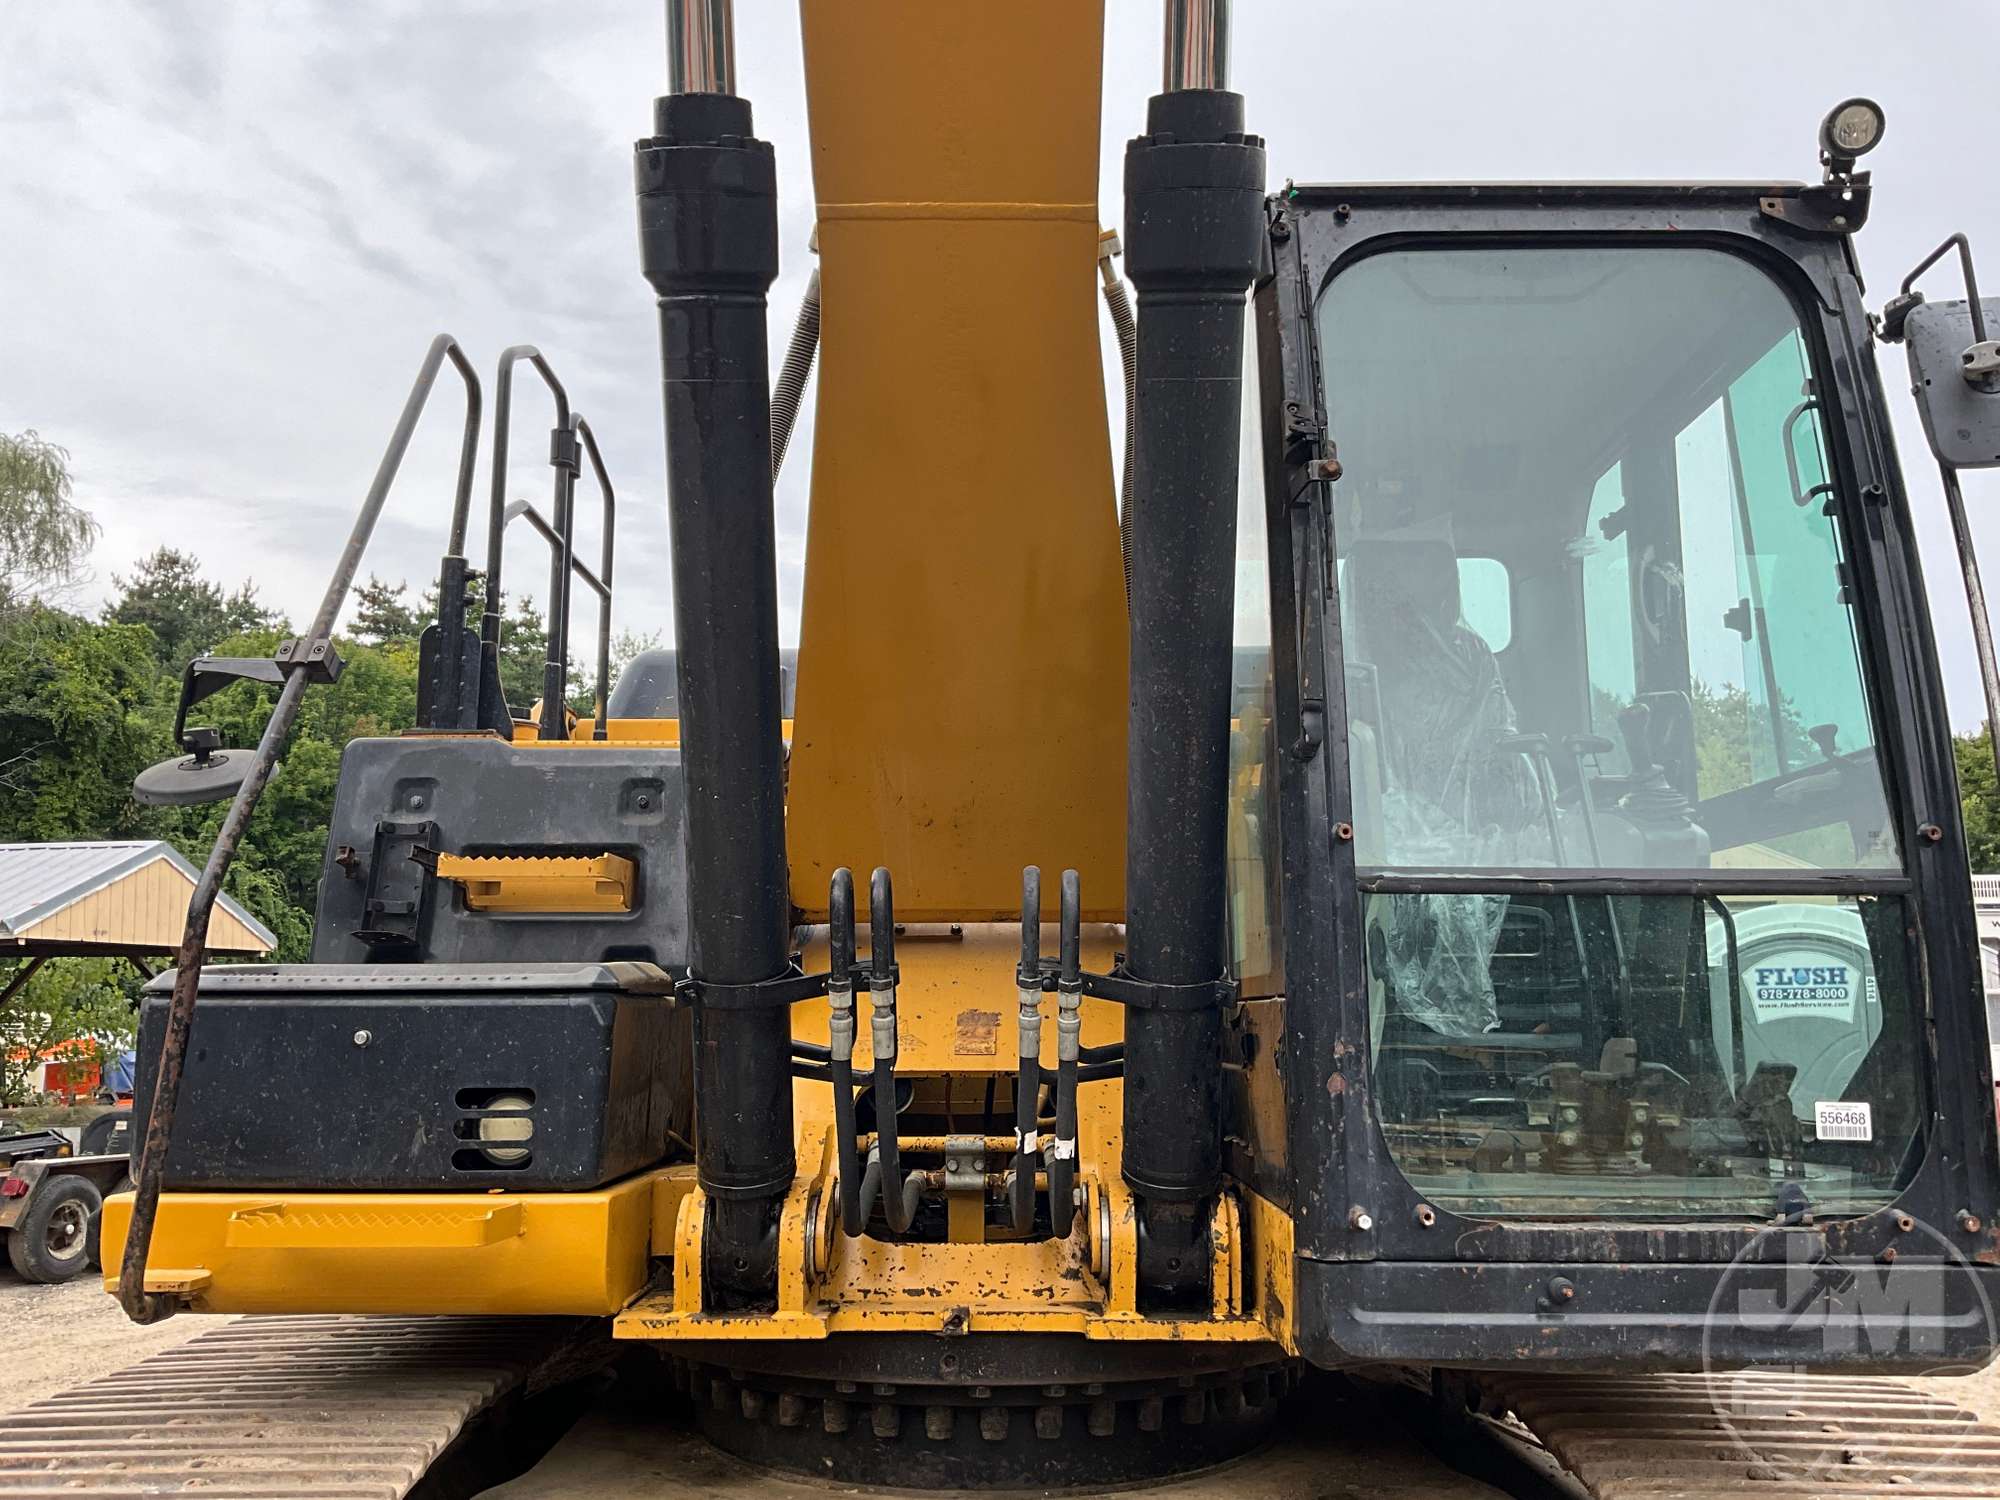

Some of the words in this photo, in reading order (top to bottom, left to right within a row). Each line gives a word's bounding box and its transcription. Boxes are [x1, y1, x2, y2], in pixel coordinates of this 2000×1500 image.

[1755, 967, 1849, 986] FLUSH
[1760, 988, 1846, 999] 978-778-8000
[1820, 1111, 1866, 1125] 556468
